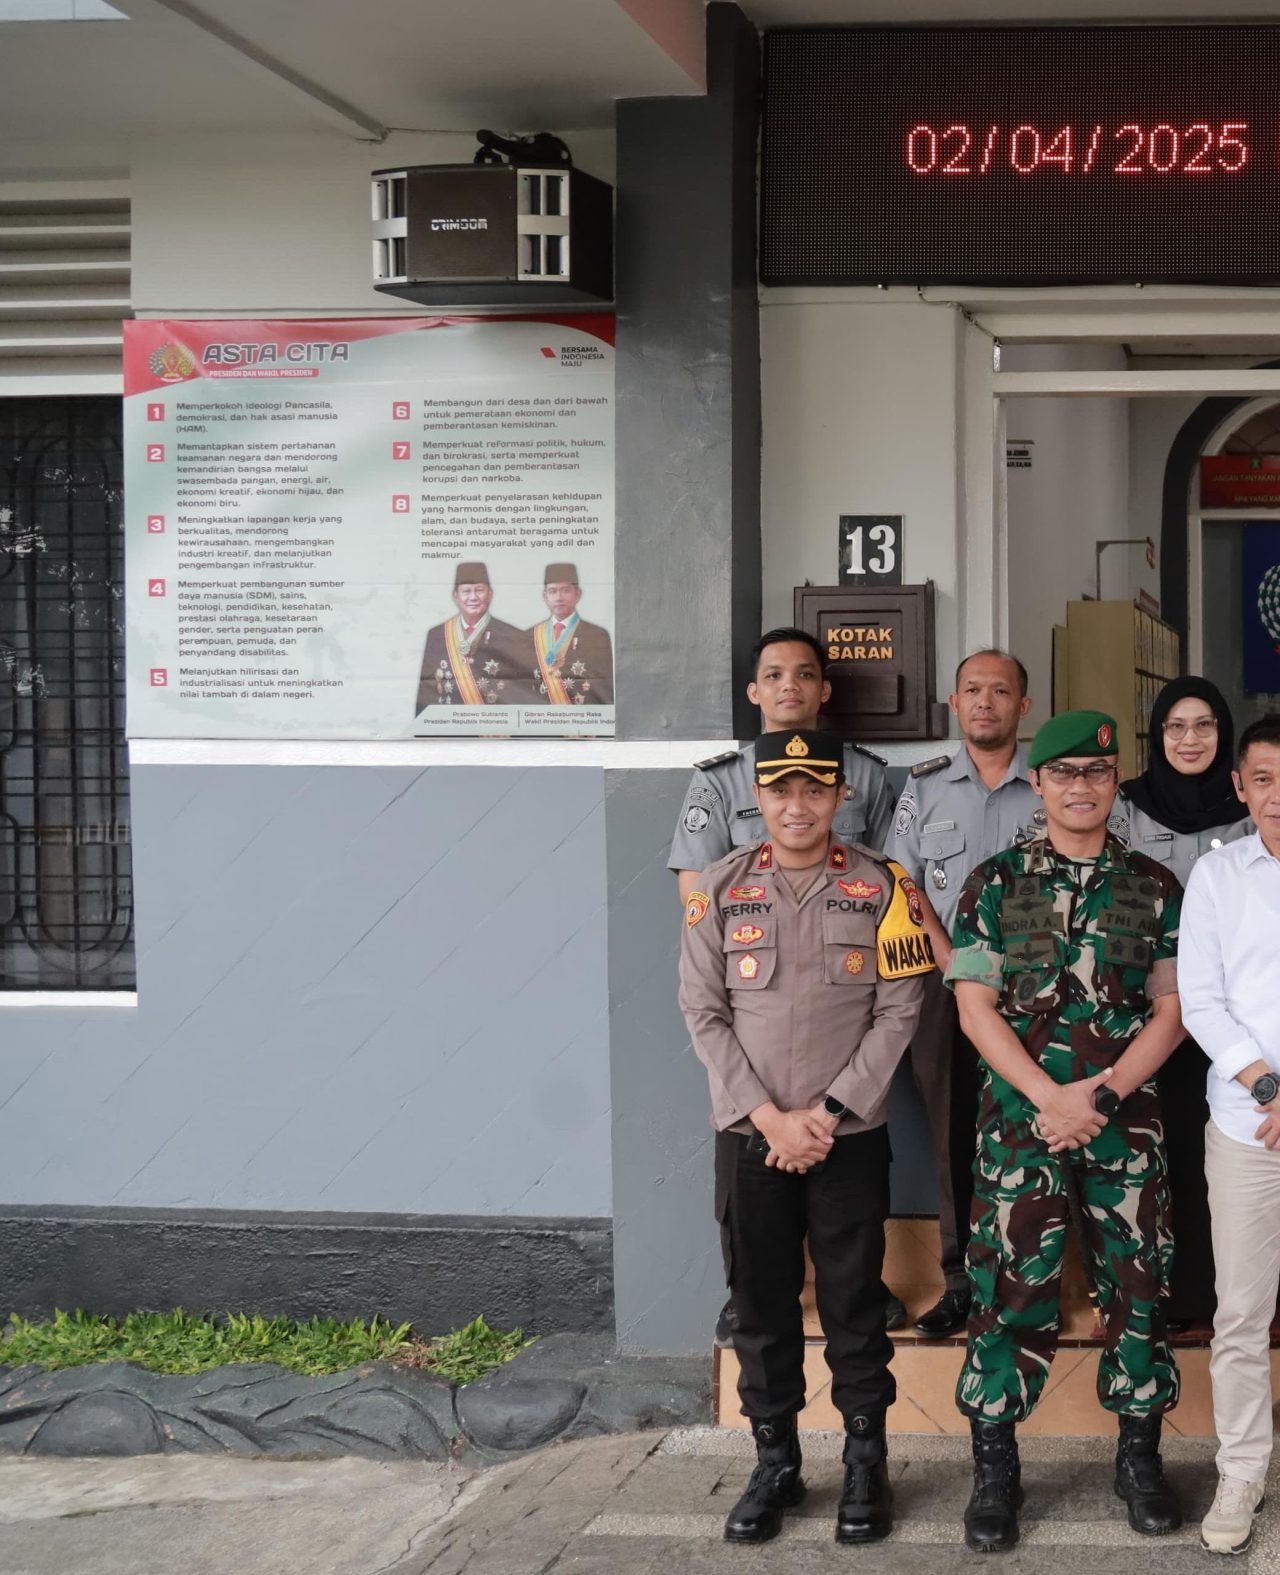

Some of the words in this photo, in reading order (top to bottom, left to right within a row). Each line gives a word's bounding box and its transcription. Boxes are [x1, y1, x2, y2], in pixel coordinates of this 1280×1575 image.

[909, 121, 1248, 175] 02/04/2025
[203, 344, 277, 363] ASTA
[286, 343, 349, 362] CITA
[209, 370, 242, 378] PRESIDEN
[242, 370, 257, 378] DAN
[280, 369, 313, 377] PRESIDEN
[176, 402, 242, 411] Memperkokoh
[245, 402, 282, 411] ideologi
[423, 399, 482, 408] Membangun
[153, 408, 160, 419] 1
[396, 406, 407, 417] 6
[422, 440, 483, 450] Memperkuat
[150, 449, 161, 460] 2
[396, 446, 407, 457] 7
[518, 451, 579, 460] memperkuat
[422, 463, 480, 472] pencegahan
[504, 463, 579, 472] pemberantasan
[422, 475, 458, 484] korupsi
[421, 494, 481, 503] Memperkuat
[484, 493, 549, 502] penyelarasan
[552, 493, 602, 502] kehidupan
[395, 499, 407, 511] 8
[421, 506, 444, 514] yang
[495, 505, 530, 514] dengan
[150, 520, 162, 531] 3
[538, 516, 598, 525] peningkatan
[519, 528, 568, 537] beragama
[421, 540, 467, 549] mencapai
[470, 540, 527, 548] masyarakat
[530, 540, 553, 548] yang
[846, 525, 896, 574] 13
[151, 583, 163, 594] 4
[827, 628, 893, 642] KOTAK
[827, 645, 893, 660] SARAN
[153, 672, 164, 684] 5
[722, 902, 773, 918] FERRY
[826, 899, 879, 915] POLRI
[1001, 919, 1038, 932] INDRA
[1105, 913, 1131, 927] TNI
[883, 935, 927, 972] WAKA
